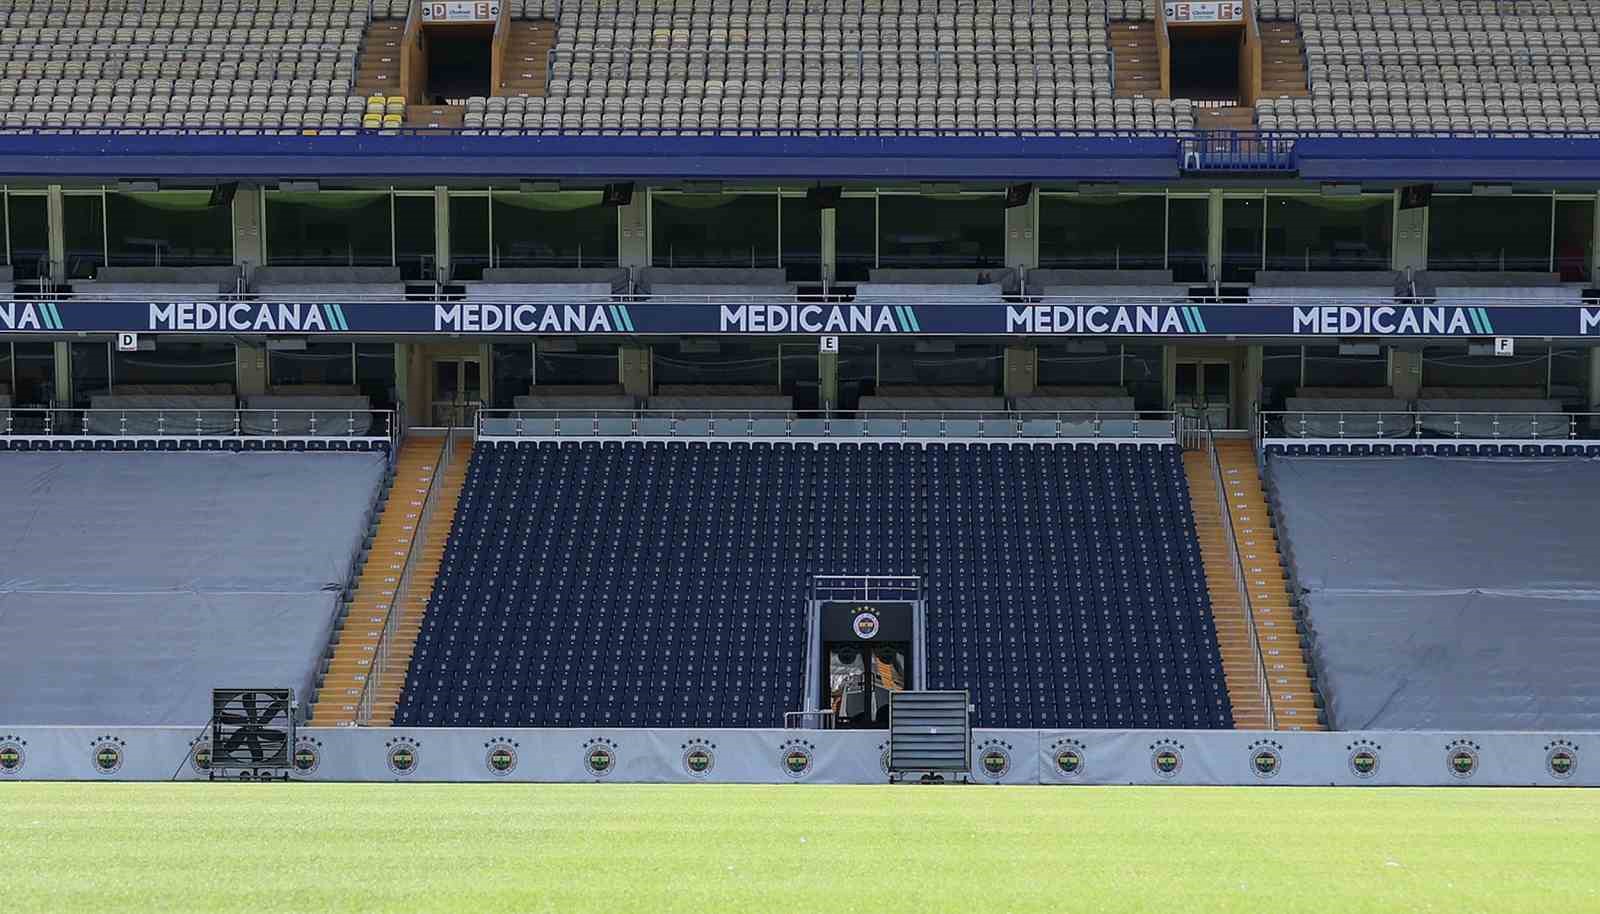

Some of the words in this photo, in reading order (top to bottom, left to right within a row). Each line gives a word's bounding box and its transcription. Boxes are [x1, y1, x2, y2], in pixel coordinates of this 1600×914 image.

[434, 4, 445, 16] D
[477, 4, 486, 16] E
[1177, 5, 1187, 16] E
[1221, 4, 1231, 16] F
[149, 303, 325, 330] MEDICANA
[434, 304, 612, 331] MEDICANA
[720, 305, 898, 332] MEDICANA
[1006, 306, 1185, 333] MEDICANA
[1293, 307, 1472, 334] MEDICANA
[123, 334, 133, 346] D
[826, 337, 833, 349] E
[1501, 339, 1509, 351] F
